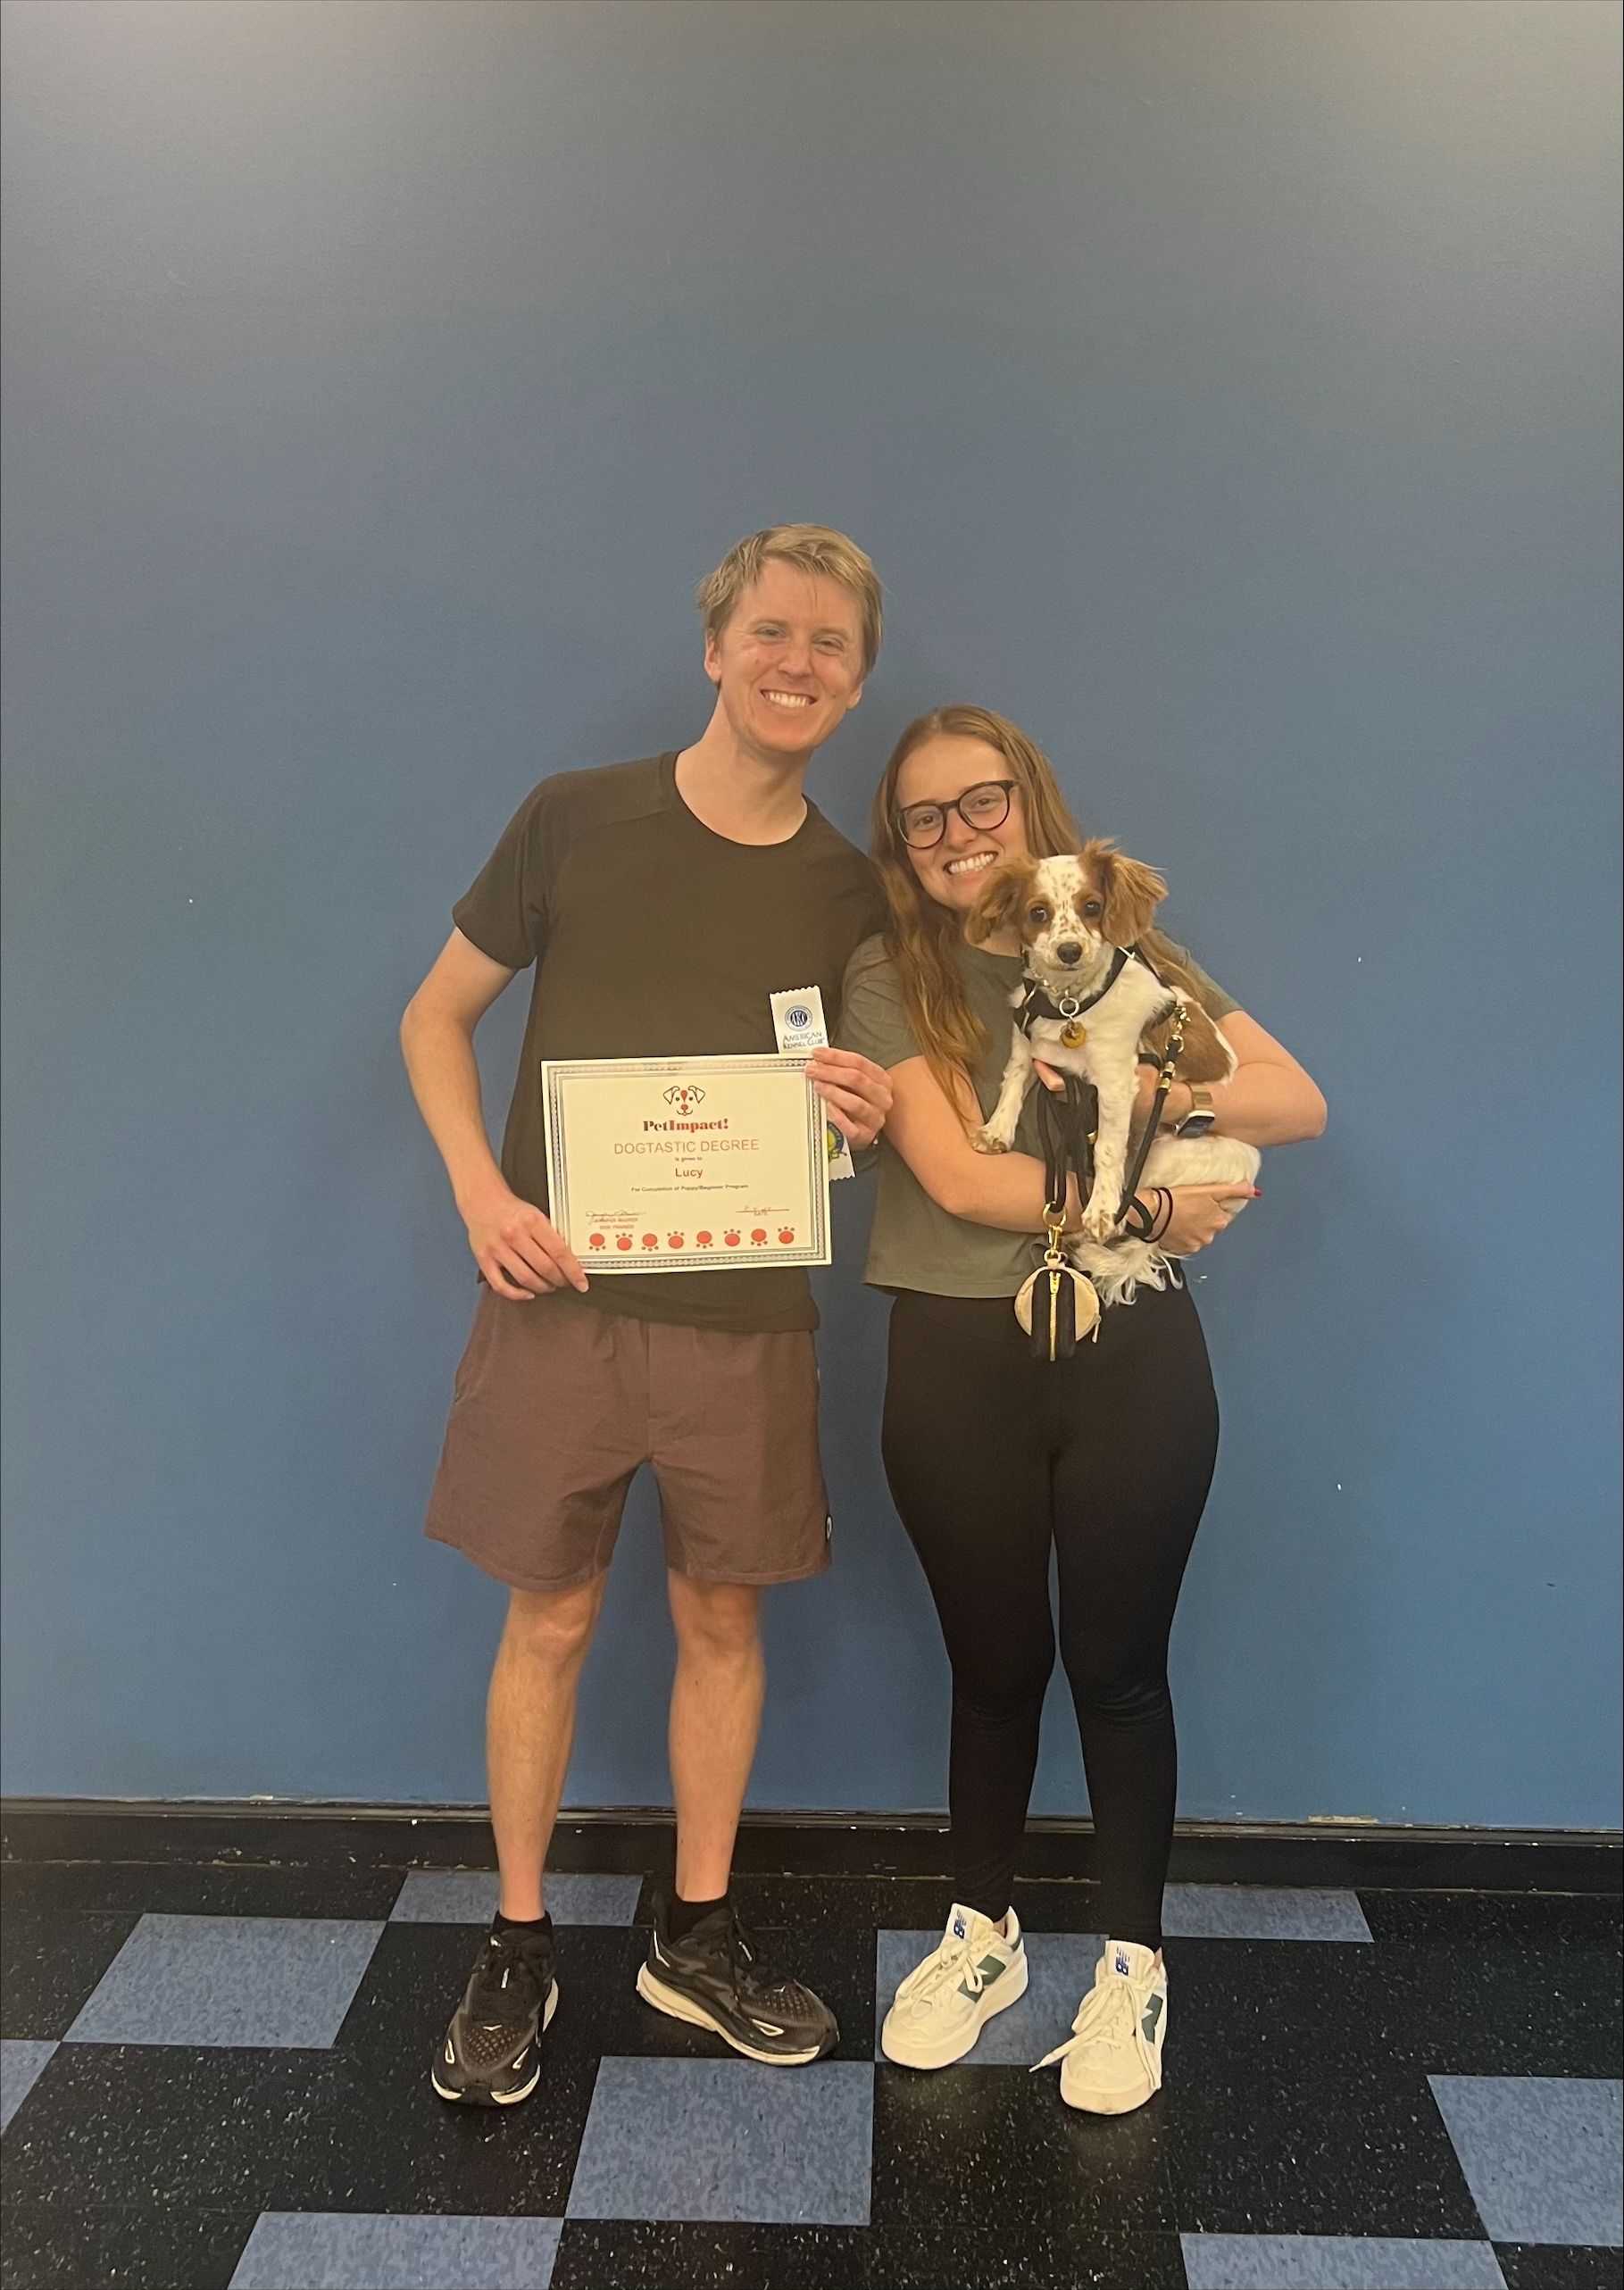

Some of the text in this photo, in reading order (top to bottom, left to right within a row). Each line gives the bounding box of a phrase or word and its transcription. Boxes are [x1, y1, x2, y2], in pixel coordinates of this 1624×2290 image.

[783, 1031, 822, 1043] AMERICAN
[643, 1118, 729, 1133] PetImpact!
[613, 1138, 760, 1154] DOGTASTIC DEGREE
[675, 1168, 704, 1178] Lucy
